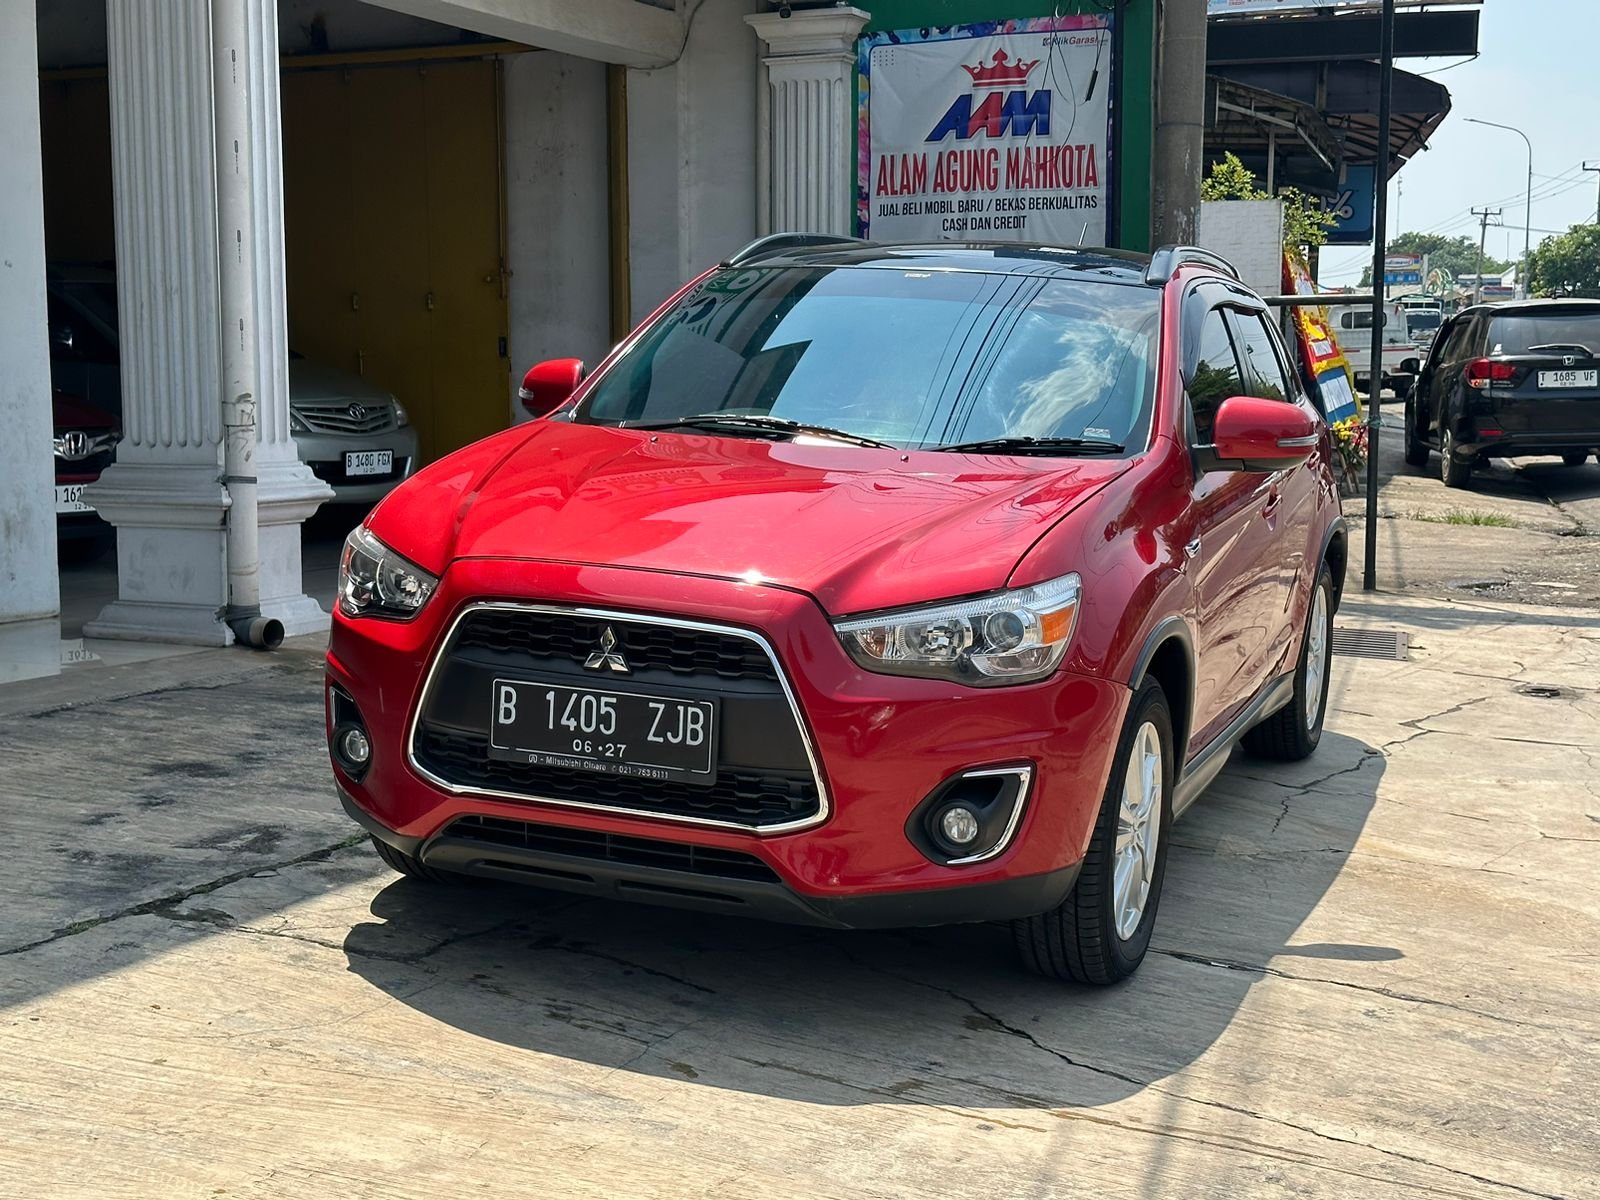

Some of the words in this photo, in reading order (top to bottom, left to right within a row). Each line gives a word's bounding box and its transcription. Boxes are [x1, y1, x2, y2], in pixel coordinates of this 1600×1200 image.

[924, 89, 1052, 143] AAM
[876, 152, 927, 197] ALAM
[932, 148, 999, 193] AGUNG
[1005, 143, 1098, 190] MAHKOTA
[878, 203, 900, 217] JUAL
[902, 202, 922, 216] BELI
[924, 200, 955, 215] MOBIL
[957, 199, 984, 214] BARU
[995, 197, 1026, 212] BEKAS
[1028, 195, 1098, 211] BERKUALITAS
[942, 218, 968, 232] CASH
[970, 217, 991, 231] DAN
[993, 215, 1027, 230] CREDIT
[1540, 372, 1546, 382] T
[1553, 371, 1577, 382] 1685
[1583, 371, 1596, 381] VF
[348, 455, 352, 467] B
[498, 684, 518, 725] B
[545, 690, 618, 736] 1405
[646, 701, 704, 746] ZJB
